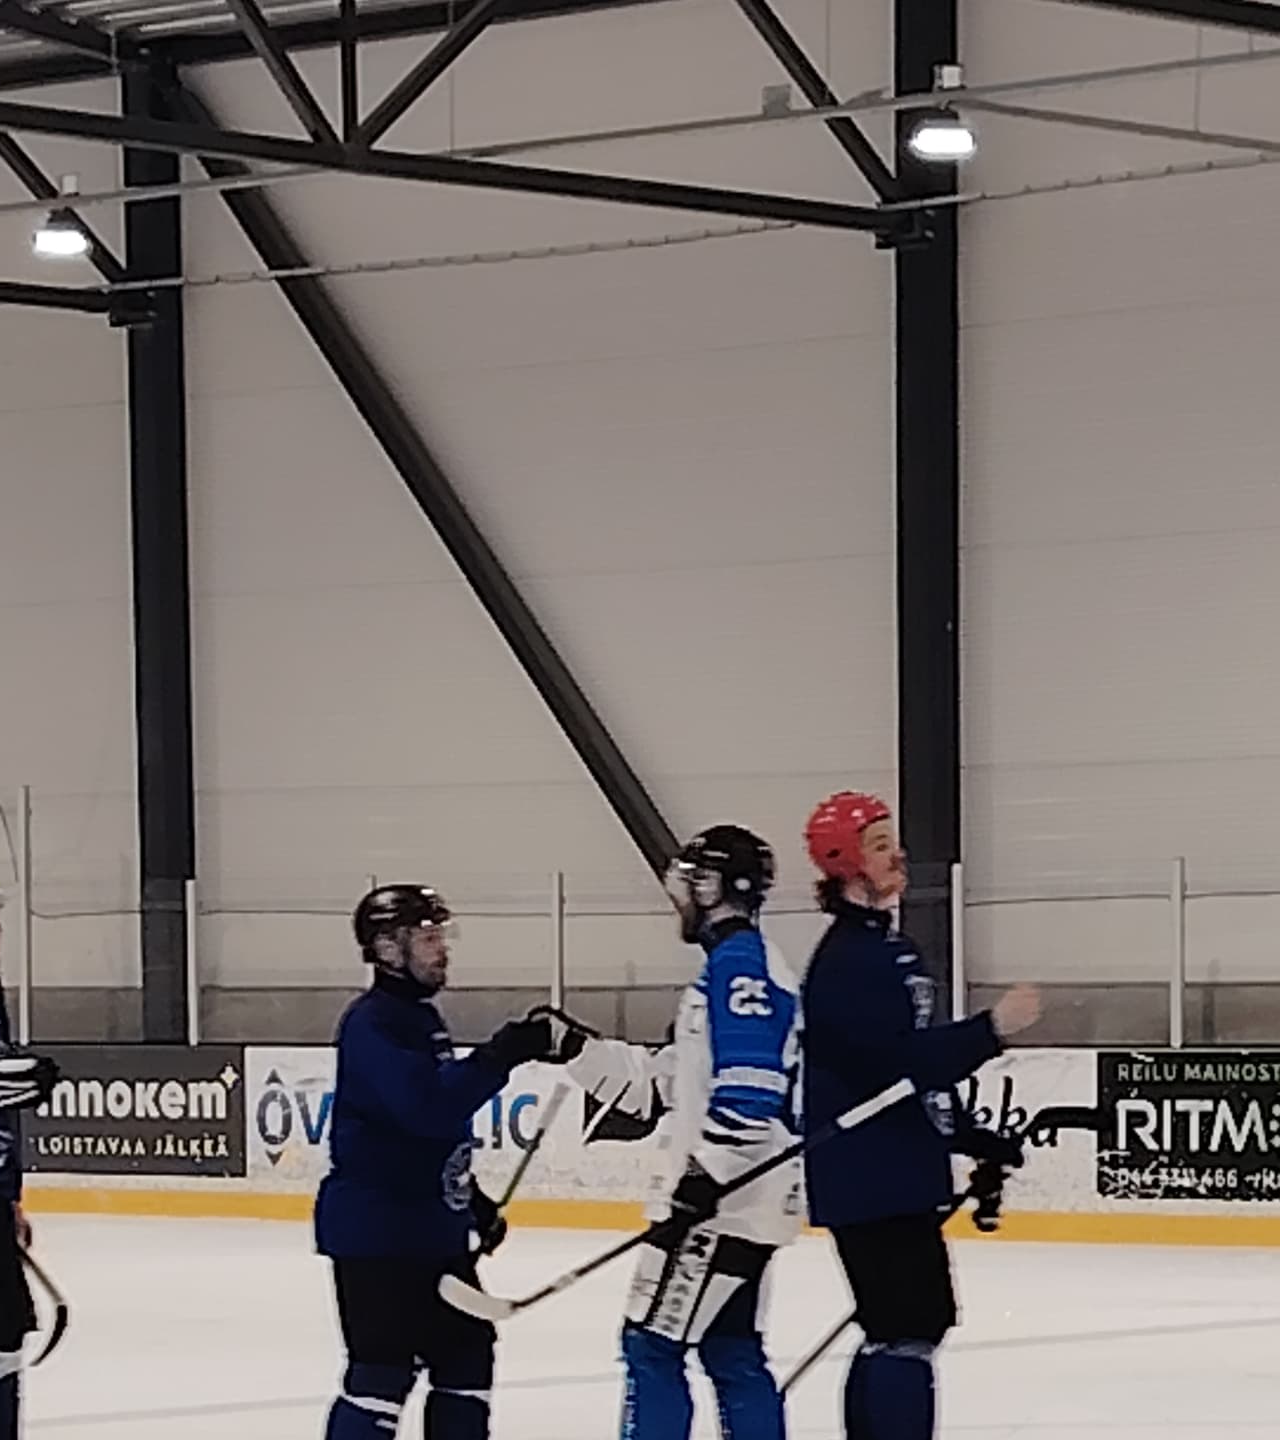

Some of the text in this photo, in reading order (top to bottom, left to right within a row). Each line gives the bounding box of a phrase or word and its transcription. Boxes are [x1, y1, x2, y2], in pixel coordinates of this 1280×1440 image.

[1117, 1063, 1178, 1082] REILU
[37, 1134, 230, 1160] LOISTAVAA JÄLKEÄ
